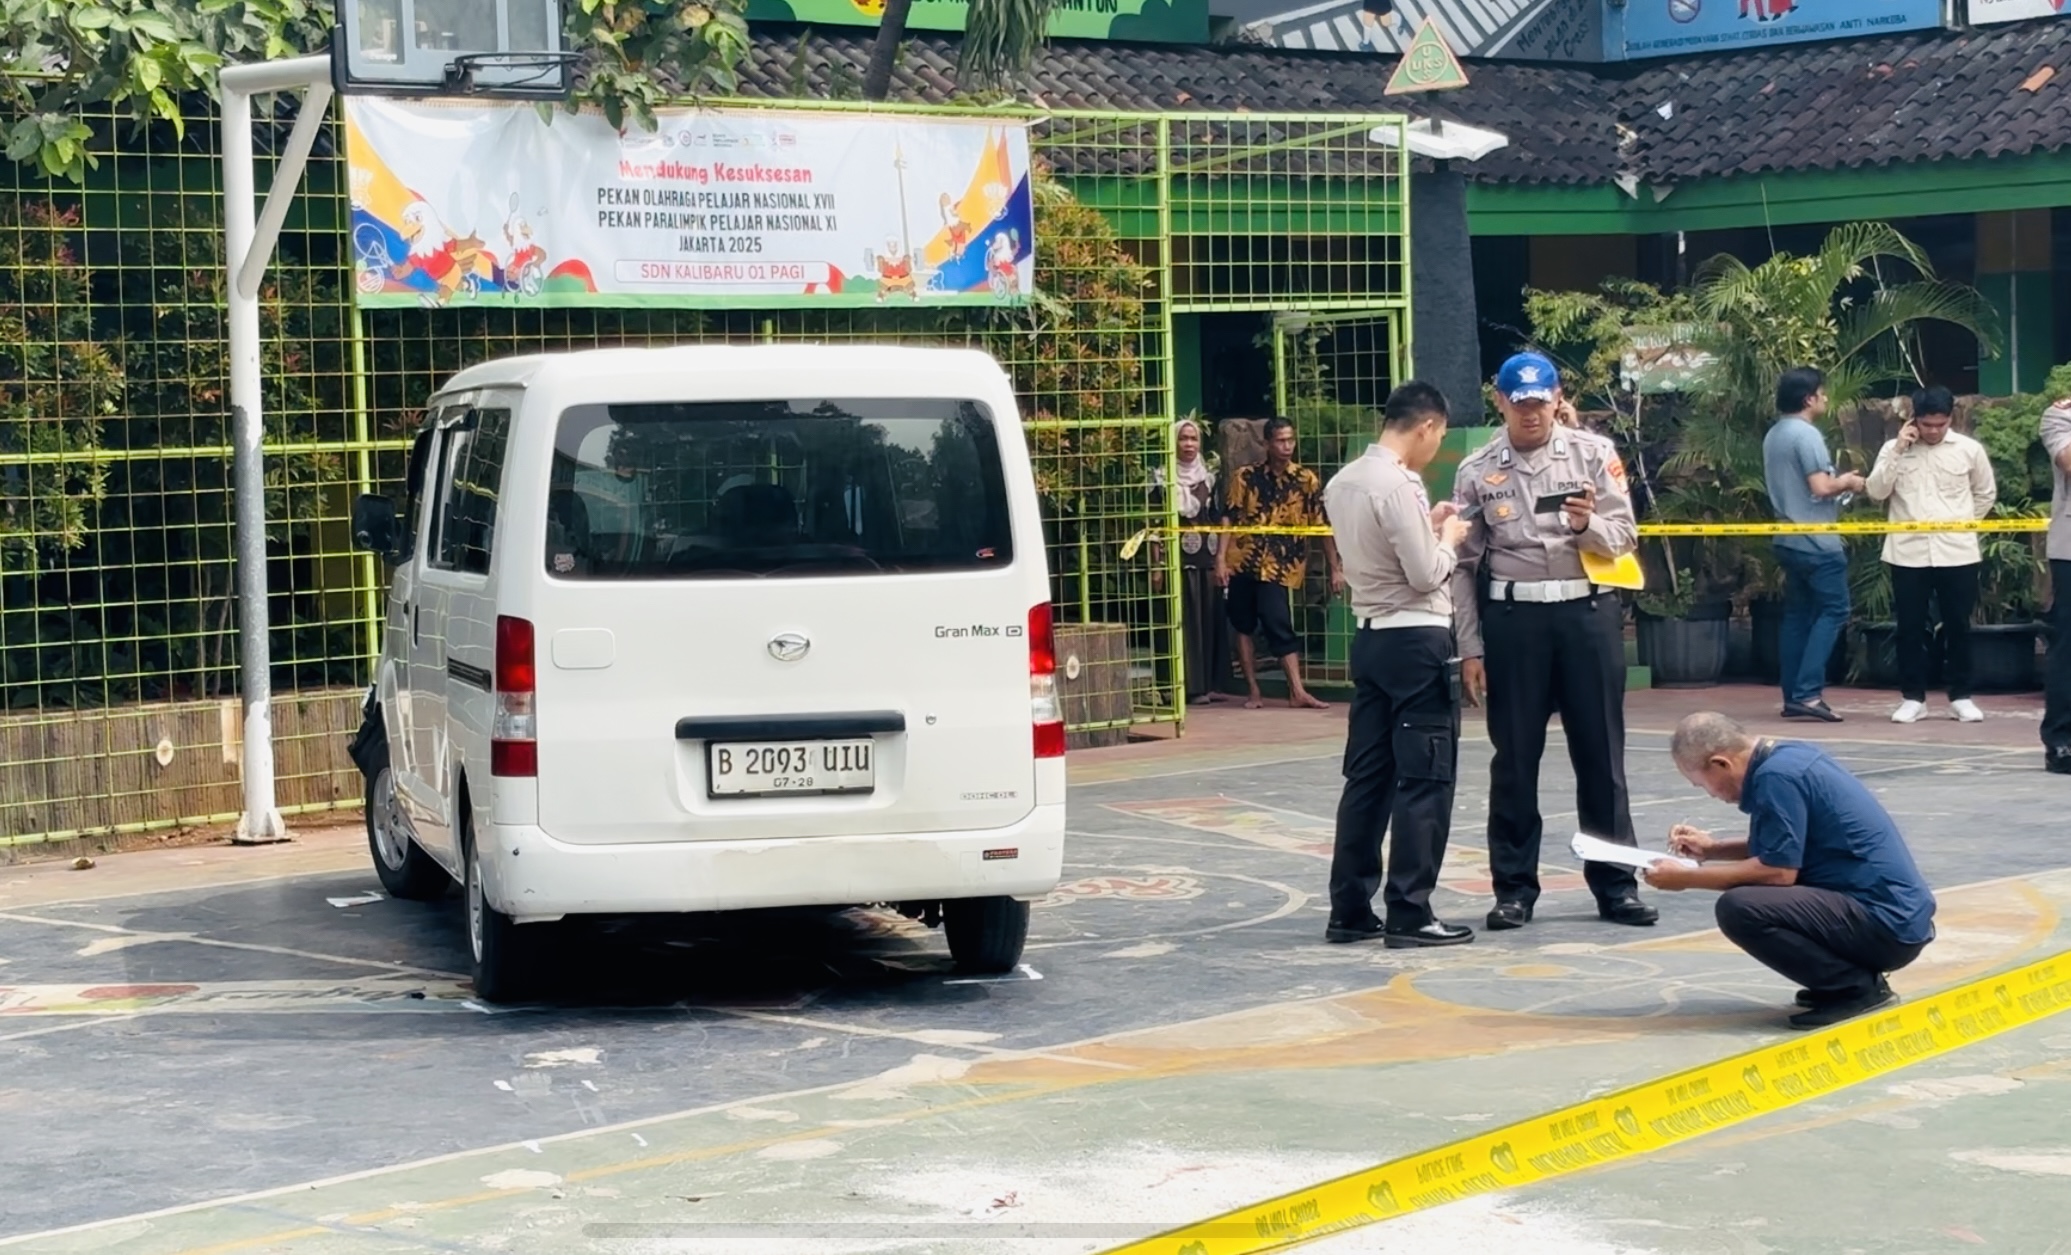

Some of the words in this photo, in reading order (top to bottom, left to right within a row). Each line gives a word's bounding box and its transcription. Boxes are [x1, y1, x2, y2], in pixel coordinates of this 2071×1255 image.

[1840, 19, 1862, 30] ANTI
[1867, 14, 1907, 27] NARKOBA
[1411, 56, 1443, 71] UKS
[618, 160, 708, 185] Mendukung
[714, 162, 812, 183] Kesuksesan
[597, 187, 640, 206] PEKAN
[643, 189, 697, 208] OLAHRAGA
[698, 191, 750, 209] PELAJAR
[753, 193, 809, 210] NASIONAL
[813, 193, 835, 210] XVII
[598, 210, 641, 228] PEKAN
[644, 211, 707, 231] PARALIMPIK
[710, 213, 763, 231] PELAJAR
[766, 214, 822, 231] NASIONAL
[824, 215, 837, 231] XI
[679, 235, 726, 254] JAKARTA
[728, 236, 762, 253] 2025
[640, 263, 671, 279] SDN
[675, 264, 743, 280] KALIBARU
[748, 265, 766, 280] 01
[771, 265, 805, 280] PAGI
[935, 625, 968, 638] Gran
[971, 624, 1000, 637] Max
[718, 748, 733, 775] B
[746, 747, 806, 774] 2093
[823, 745, 869, 772] UIU
